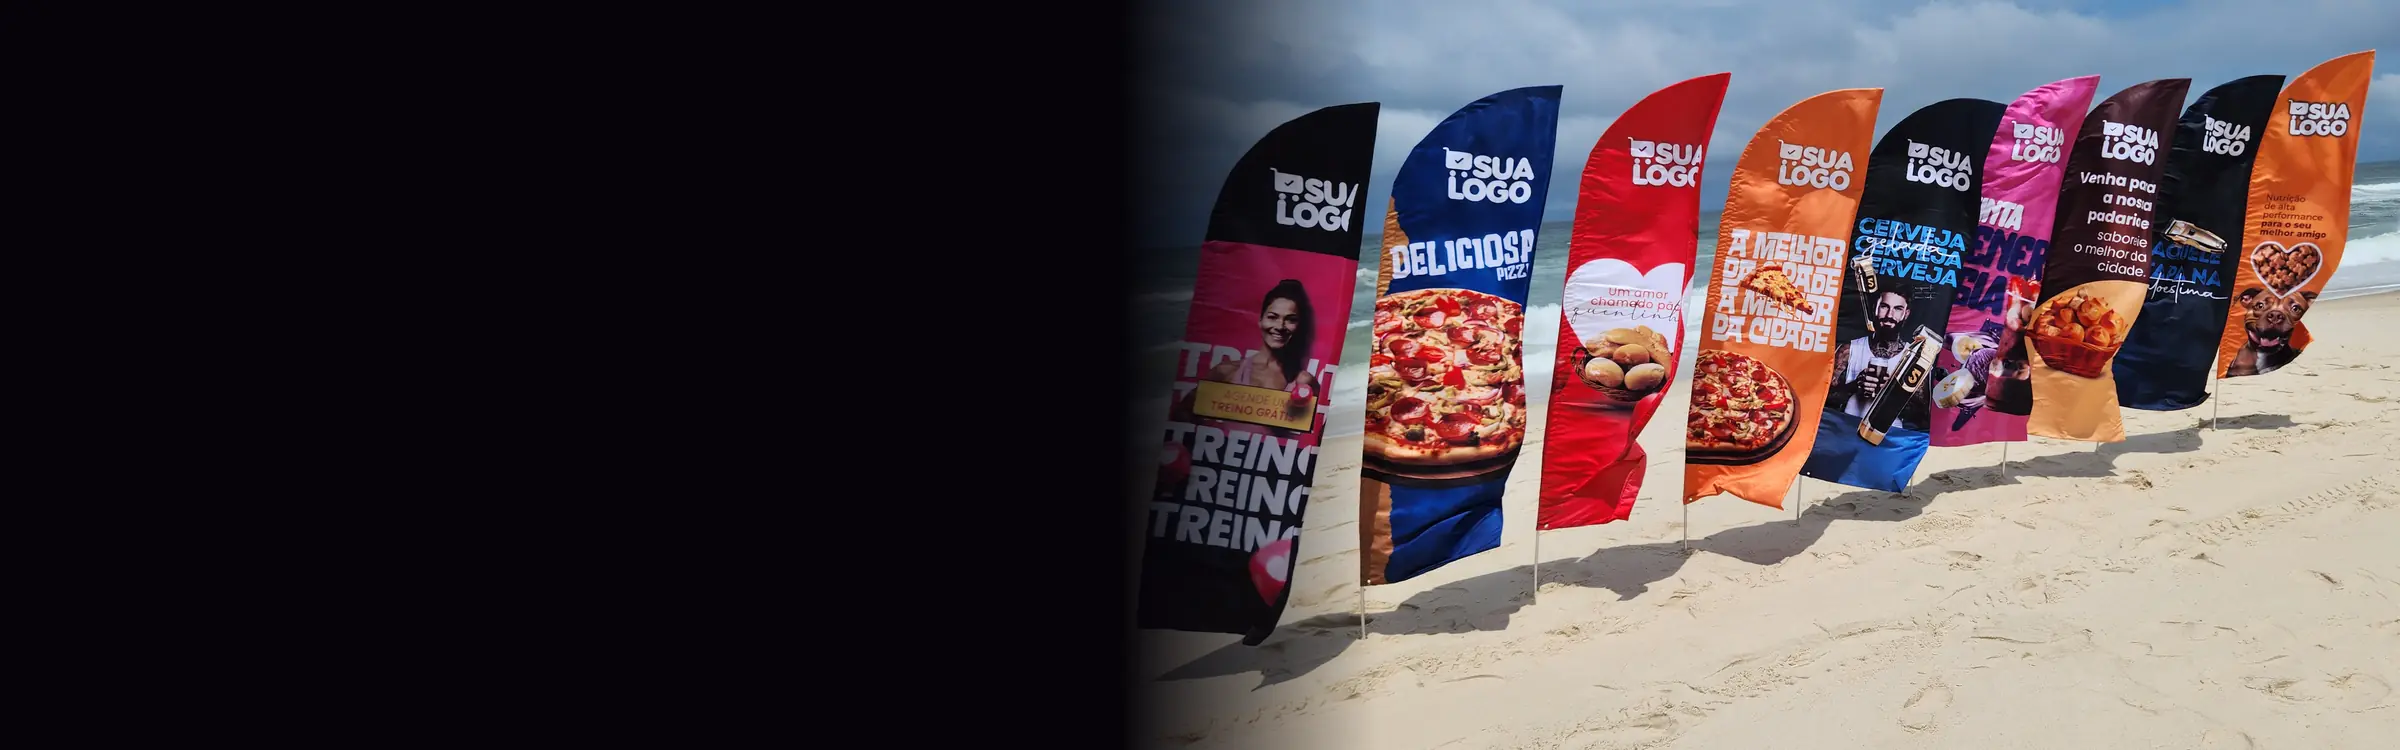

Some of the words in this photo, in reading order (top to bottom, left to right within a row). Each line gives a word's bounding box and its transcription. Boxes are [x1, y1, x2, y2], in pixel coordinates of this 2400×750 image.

[2308, 103, 2350, 120] SUA
[2034, 126, 2064, 146] SUA
[2123, 124, 2159, 150] SUA
[2213, 119, 2250, 142] SUA
[2289, 117, 2347, 137] LOGO
[2011, 141, 2061, 163] LOGO
[2101, 140, 2155, 166] LOGO
[2203, 132, 2245, 157] LOGO
[1472, 155, 1535, 181] SUA
[1801, 146, 1854, 172] SUA
[1928, 147, 1973, 175] SUA
[1778, 165, 1851, 191] LOGO
[1906, 162, 1971, 192] LOGO
[2080, 171, 2126, 187] Venha
[1447, 176, 1532, 204] LOGO
[2103, 194, 2112, 204] a
[2266, 193, 2306, 204] Nutrição
[2262, 212, 2324, 223] performance
[2264, 202, 2275, 210] de
[2278, 202, 2296, 211] alta
[1858, 217, 1966, 252] CERVEJA
[2259, 229, 2293, 237] melhor
[2296, 230, 2327, 239] amigo
[2261, 220, 2282, 229] para
[2293, 221, 2312, 229] seu
[1728, 228, 1751, 258] A
[1753, 231, 1846, 269] MELHOR
[1854, 235, 1963, 270] CERVEJA
[2074, 243, 2082, 252] o
[2085, 243, 2129, 260] melhor
[2130, 251, 2147, 263] da
[1853, 255, 1958, 288] ERVEJA
[2097, 261, 2146, 278] cidade.
[2192, 267, 2221, 287] NA
[1590, 297, 1654, 309] chamado
[1609, 287, 1630, 296] Um
[1634, 289, 1669, 299] amor
[1717, 285, 1739, 314] A
[1711, 313, 1746, 344] DA
[1748, 316, 1832, 353] CIDADE
[1211, 401, 1253, 415] TREINO
[1185, 465, 1304, 516] REIN
[1151, 502, 1293, 553] TREIN
